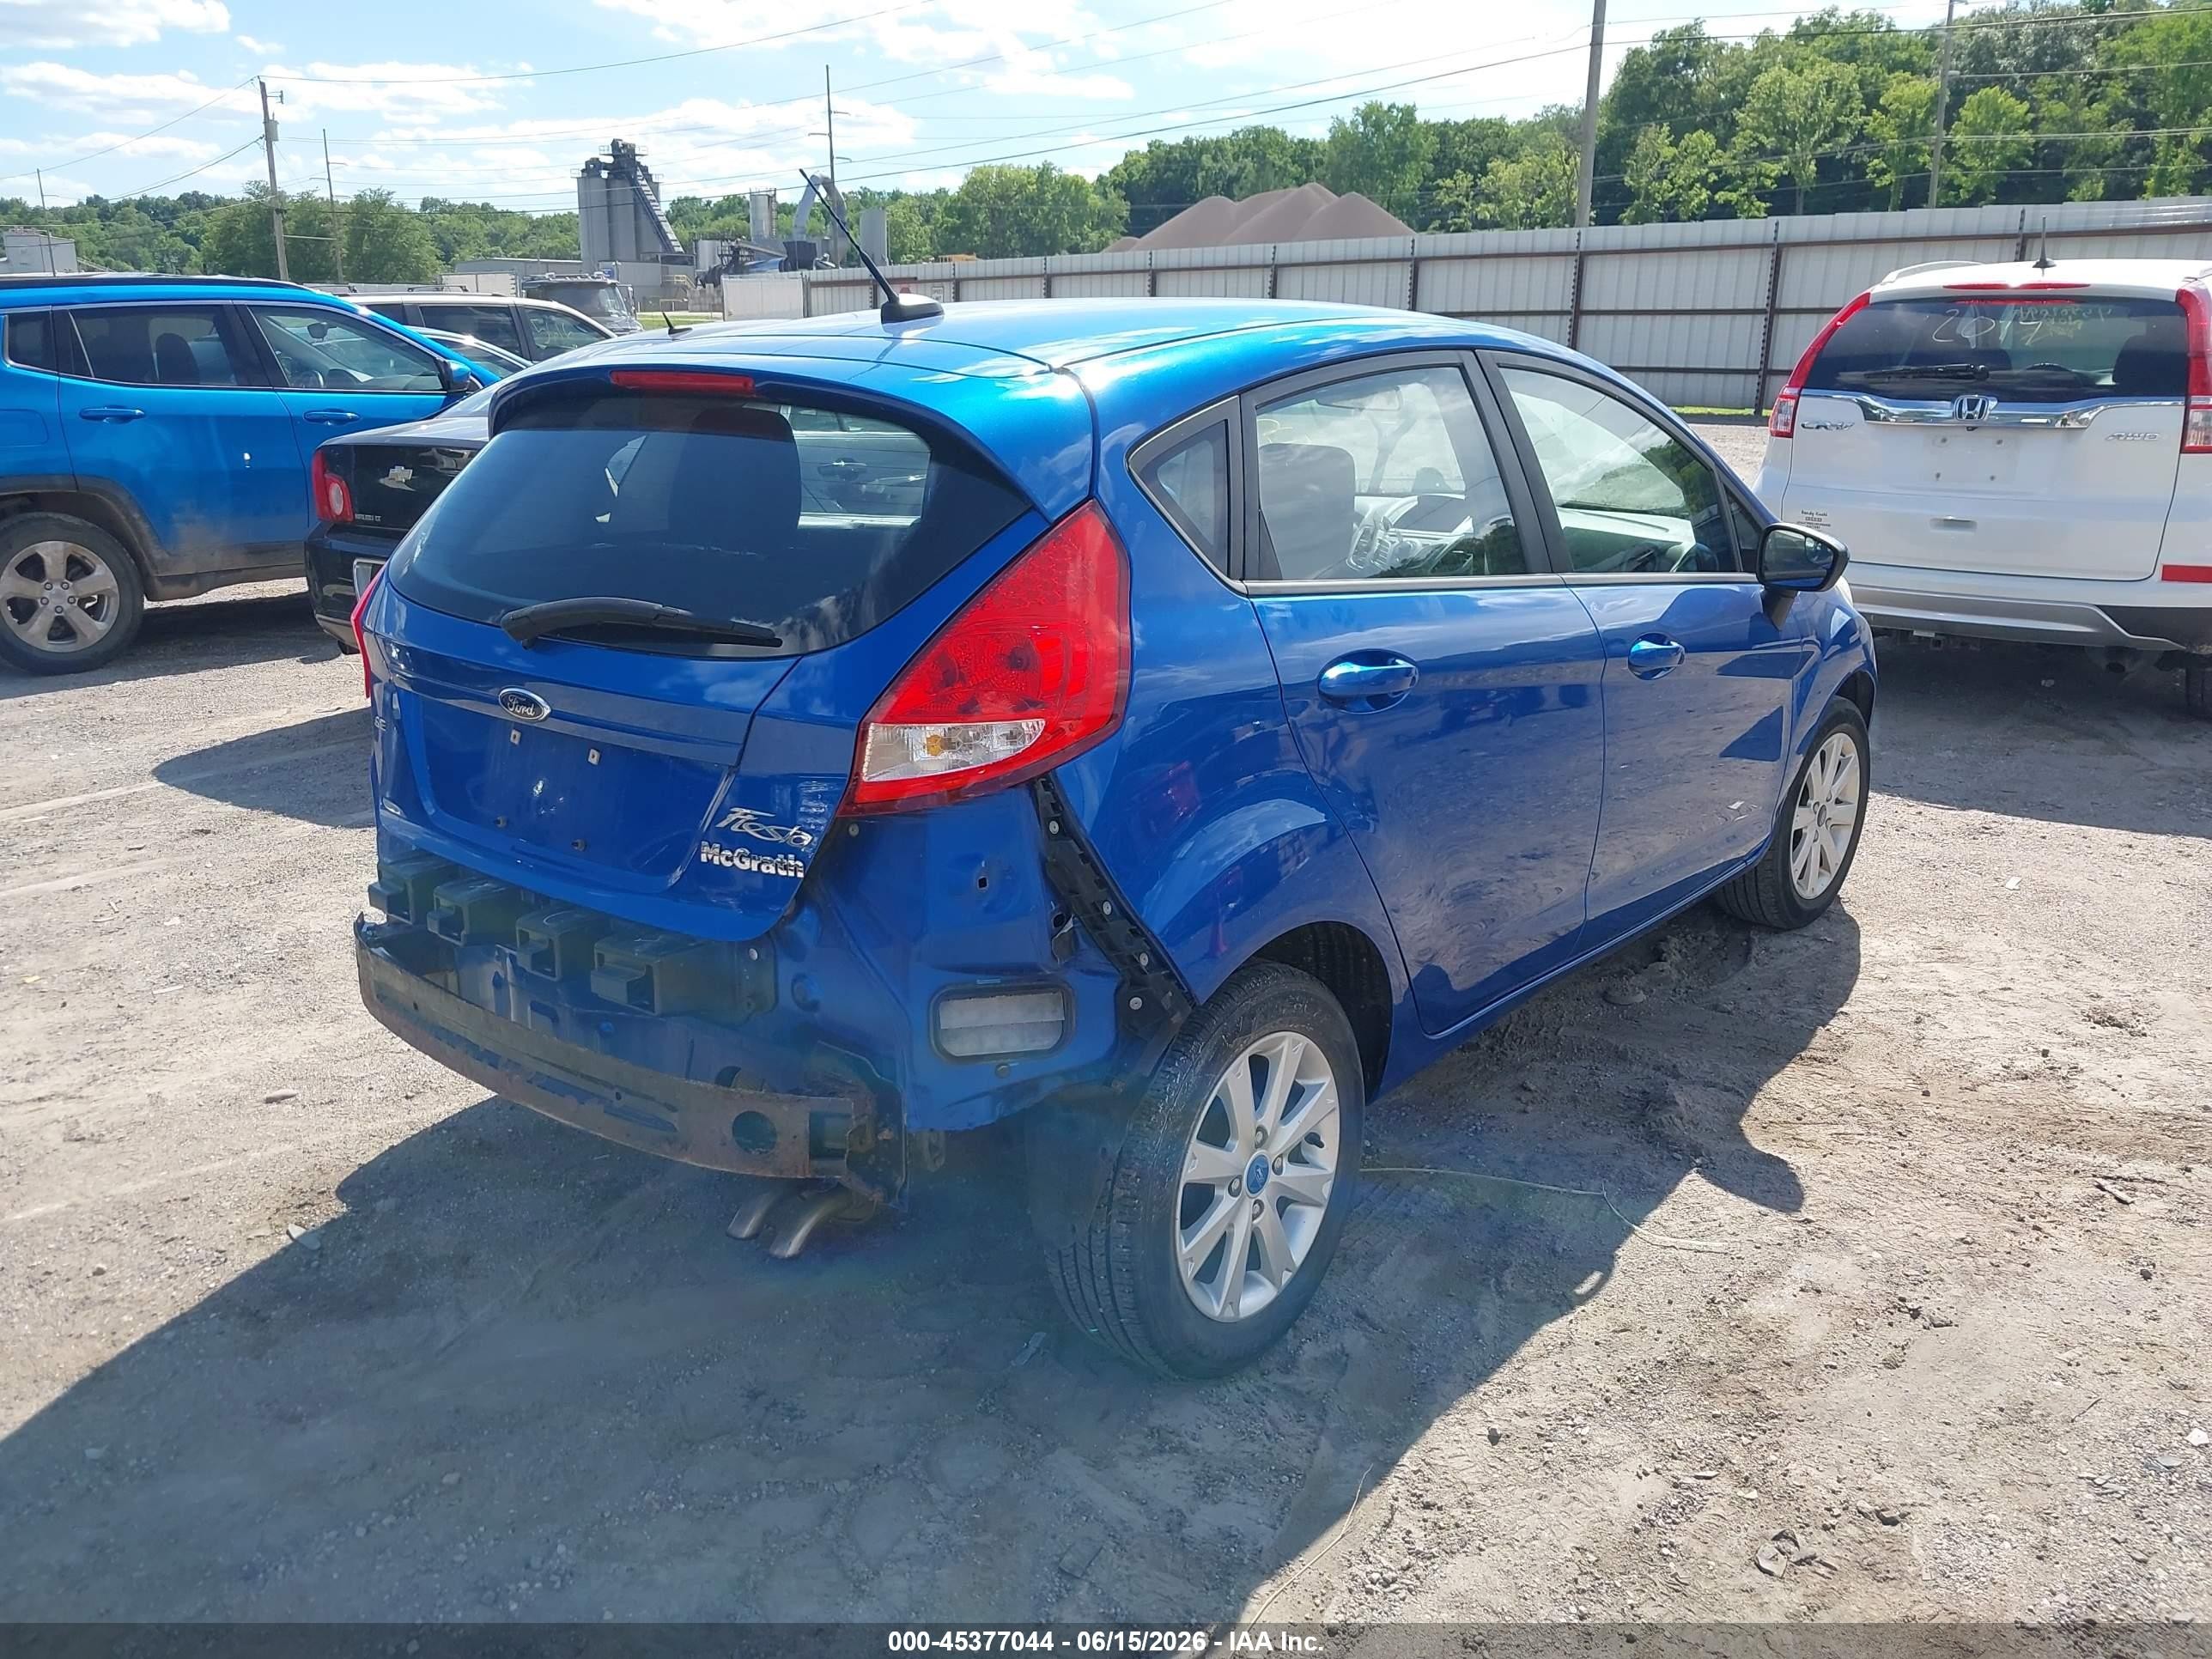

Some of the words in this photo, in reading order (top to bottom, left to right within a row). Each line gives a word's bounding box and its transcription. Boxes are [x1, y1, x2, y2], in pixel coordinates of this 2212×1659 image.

[507, 694, 536, 716] Ford
[374, 716, 386, 732] SE
[715, 807, 813, 848] Fiesta
[700, 841, 805, 878] McGrath
